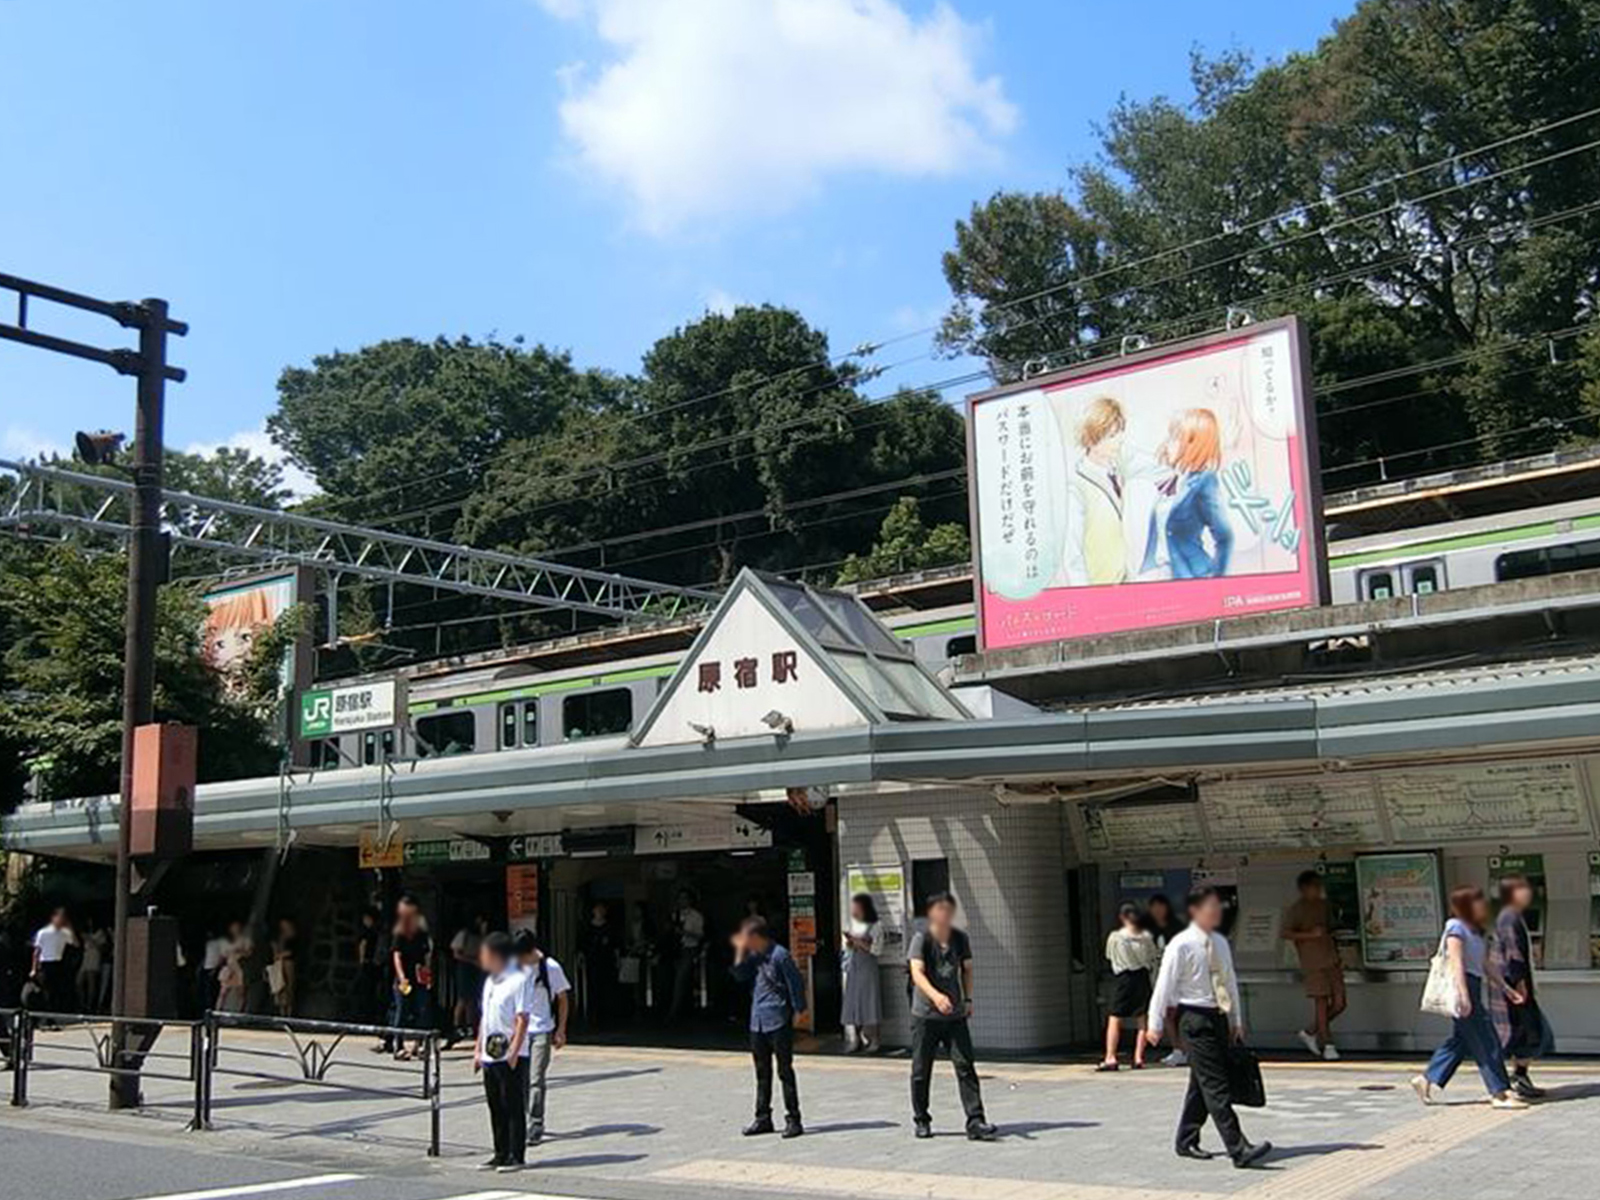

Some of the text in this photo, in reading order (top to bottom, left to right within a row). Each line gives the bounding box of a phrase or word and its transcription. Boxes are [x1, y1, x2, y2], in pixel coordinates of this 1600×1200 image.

[997, 408, 1015, 543] パスワードだけだぜ
[1017, 406, 1038, 578] 本当にお前を守れるのは
[698, 651, 798, 693] 原宿駅
[304, 698, 330, 720] JR
[336, 692, 372, 712] 原宿駅
[366, 710, 392, 721] Station
